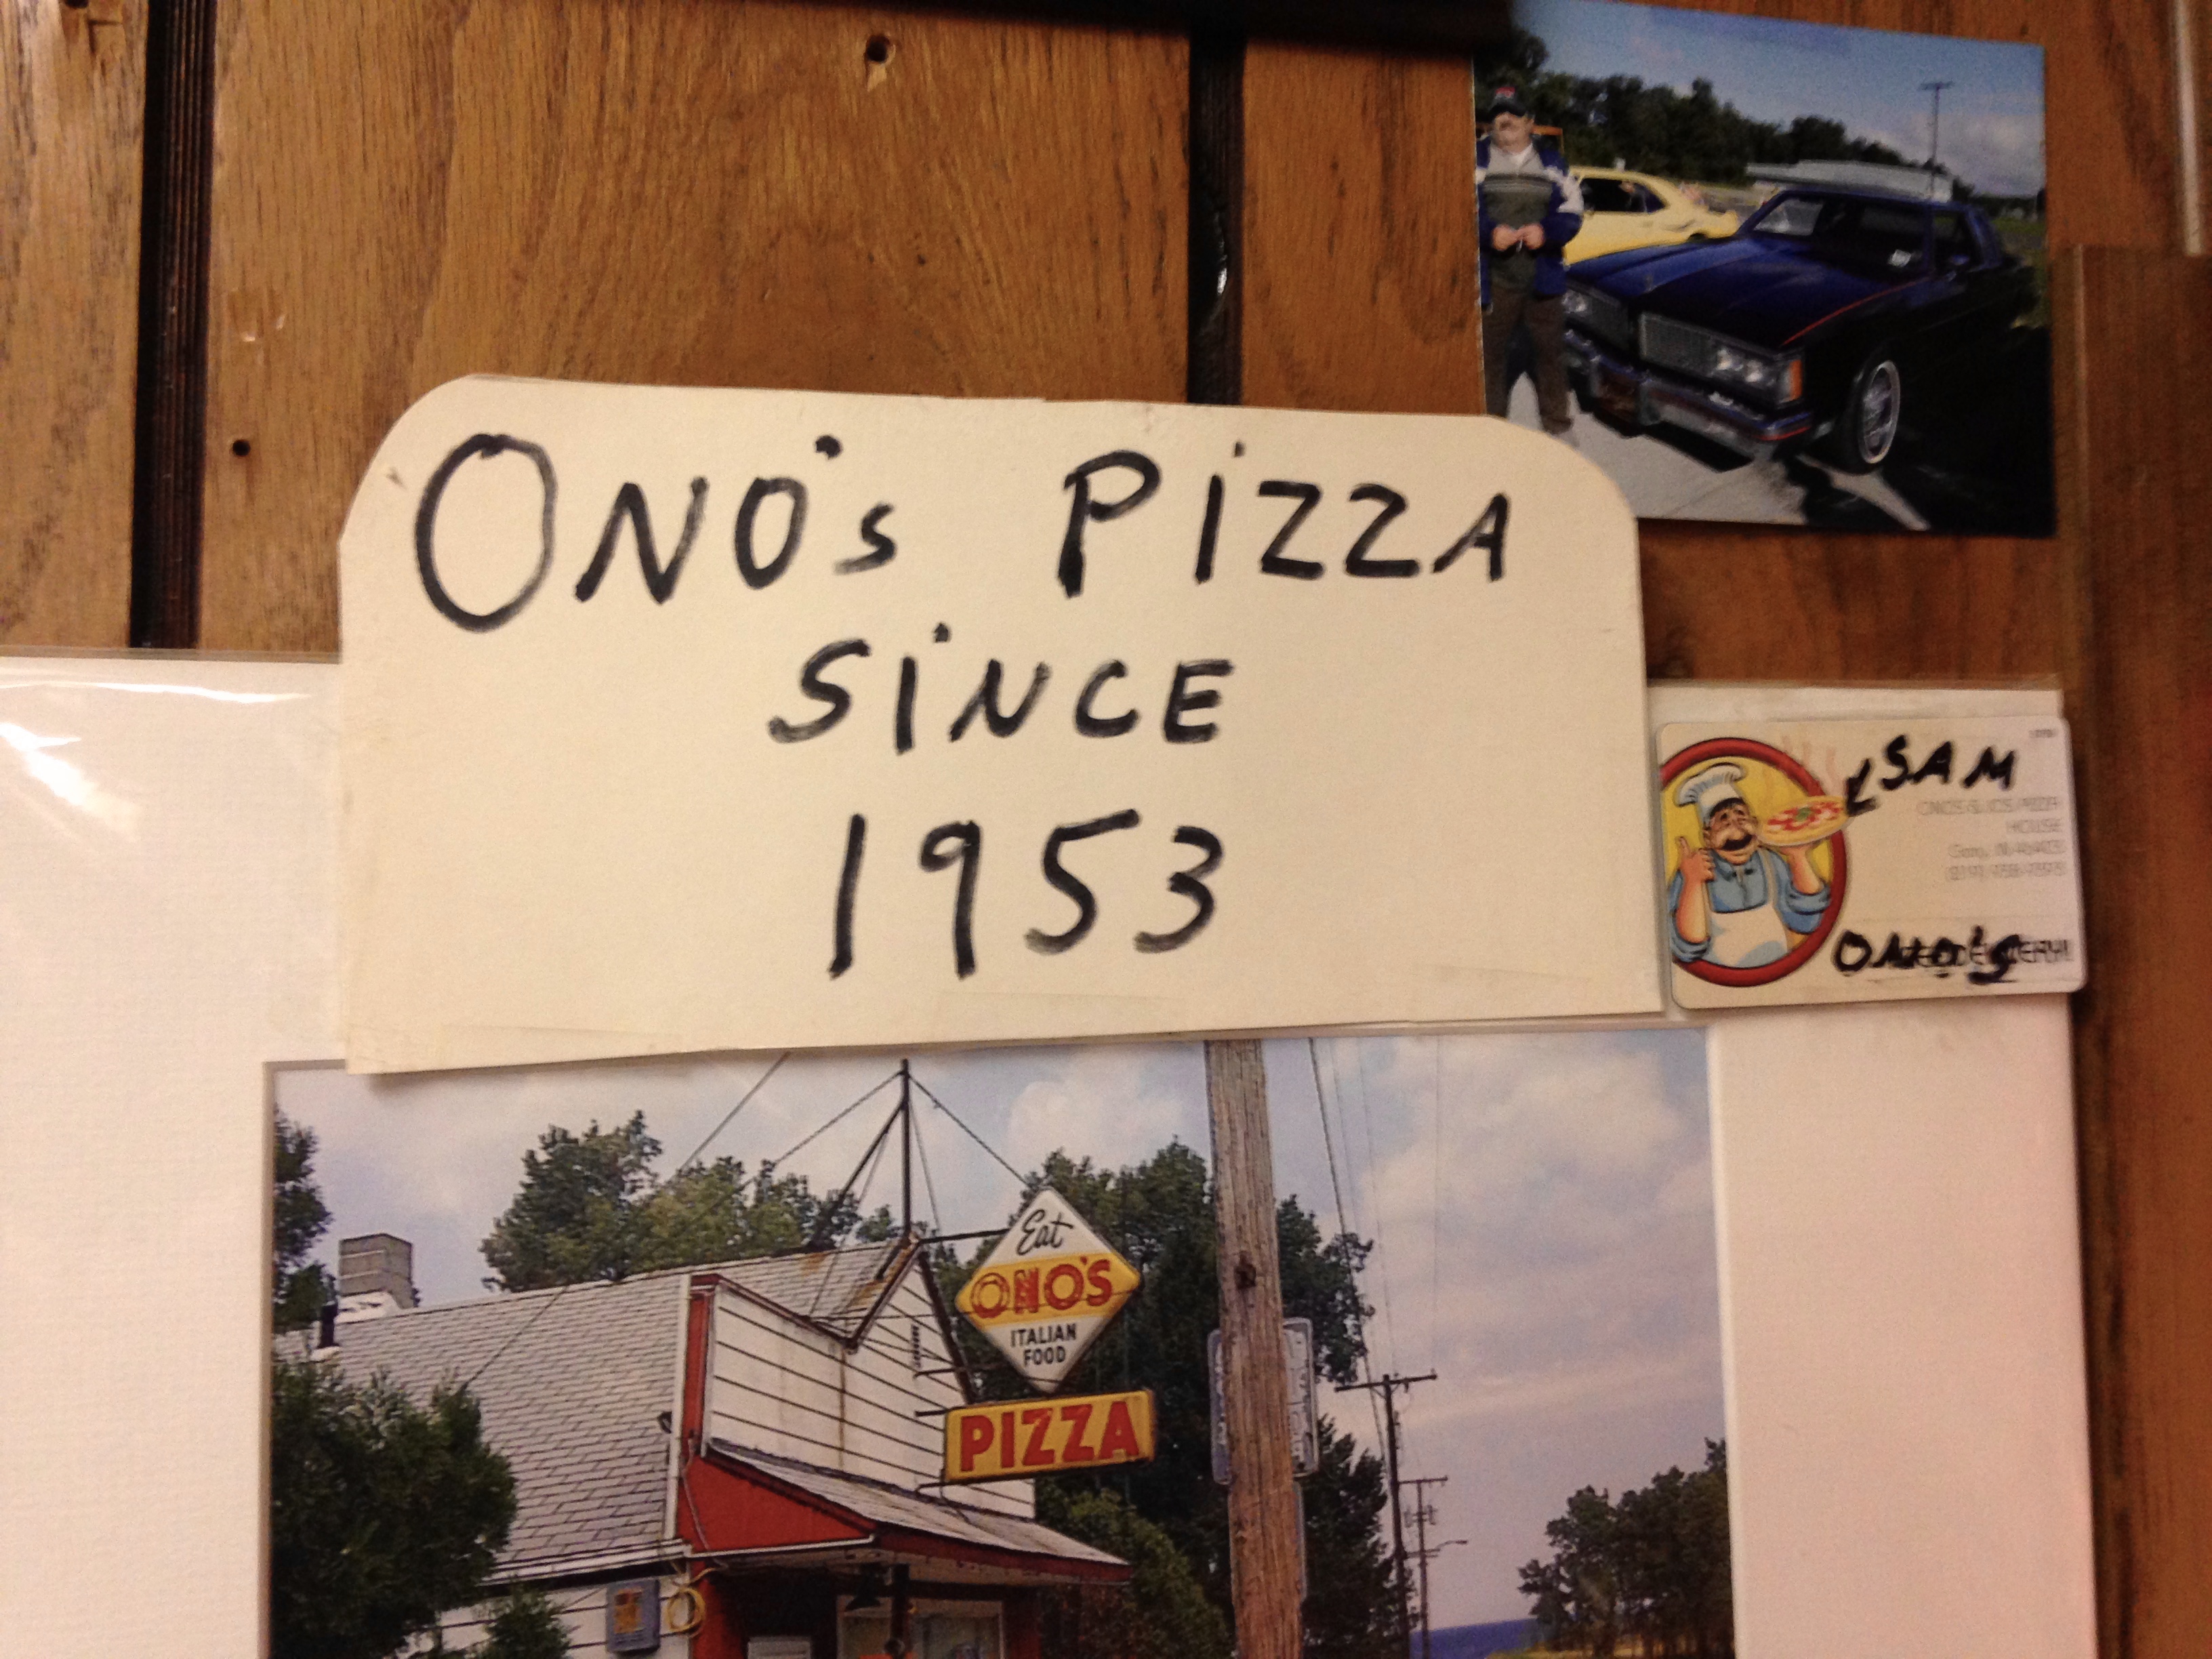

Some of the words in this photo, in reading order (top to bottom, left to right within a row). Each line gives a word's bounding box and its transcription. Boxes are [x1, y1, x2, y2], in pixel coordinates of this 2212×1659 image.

[1881, 735, 2015, 791] SAM
[828, 808, 1223, 979] 1953
[1017, 1208, 1073, 1255] Eat
[970, 1256, 1113, 1319] ONO'S
[1010, 1323, 1078, 1348] ITALIAN
[1023, 1347, 1067, 1366] FOOD
[960, 1400, 1140, 1473] PIZZA
